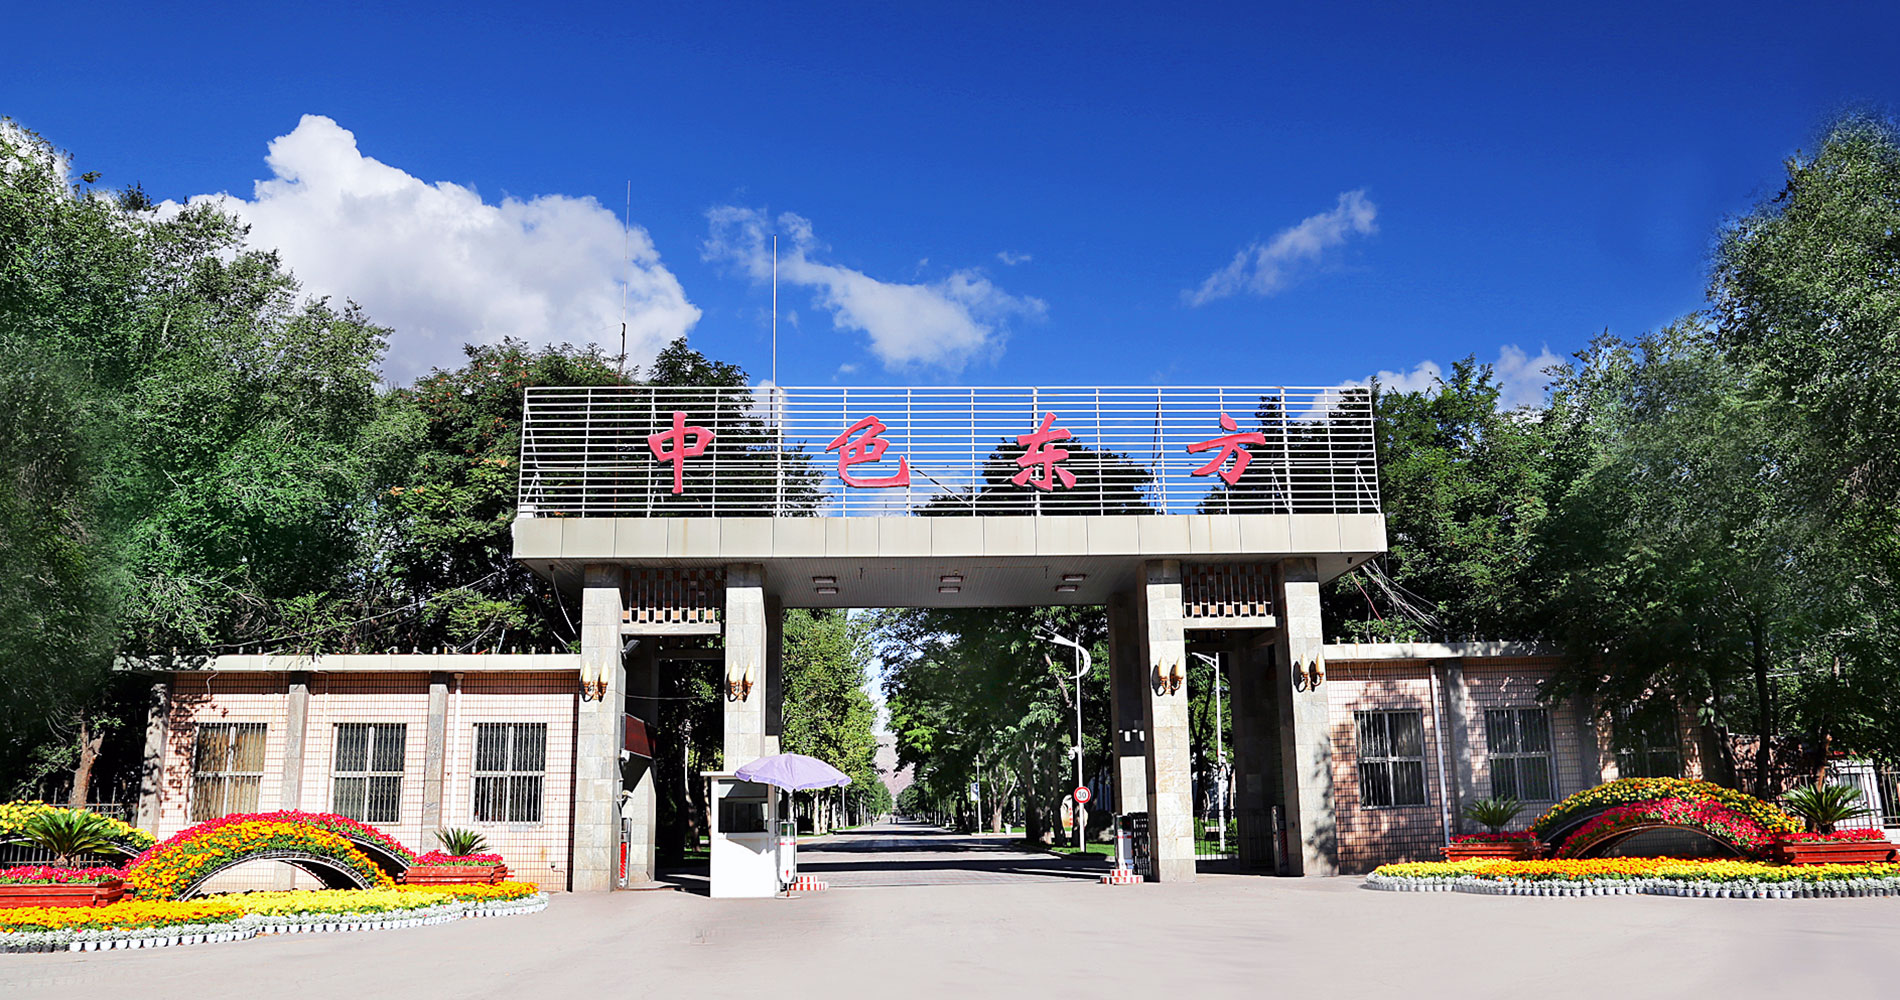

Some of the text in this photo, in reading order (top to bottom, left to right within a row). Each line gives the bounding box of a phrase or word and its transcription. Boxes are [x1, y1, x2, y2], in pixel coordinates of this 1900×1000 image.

[647, 411, 1267, 494] 中色东方
[1078, 791, 1087, 799] 30
